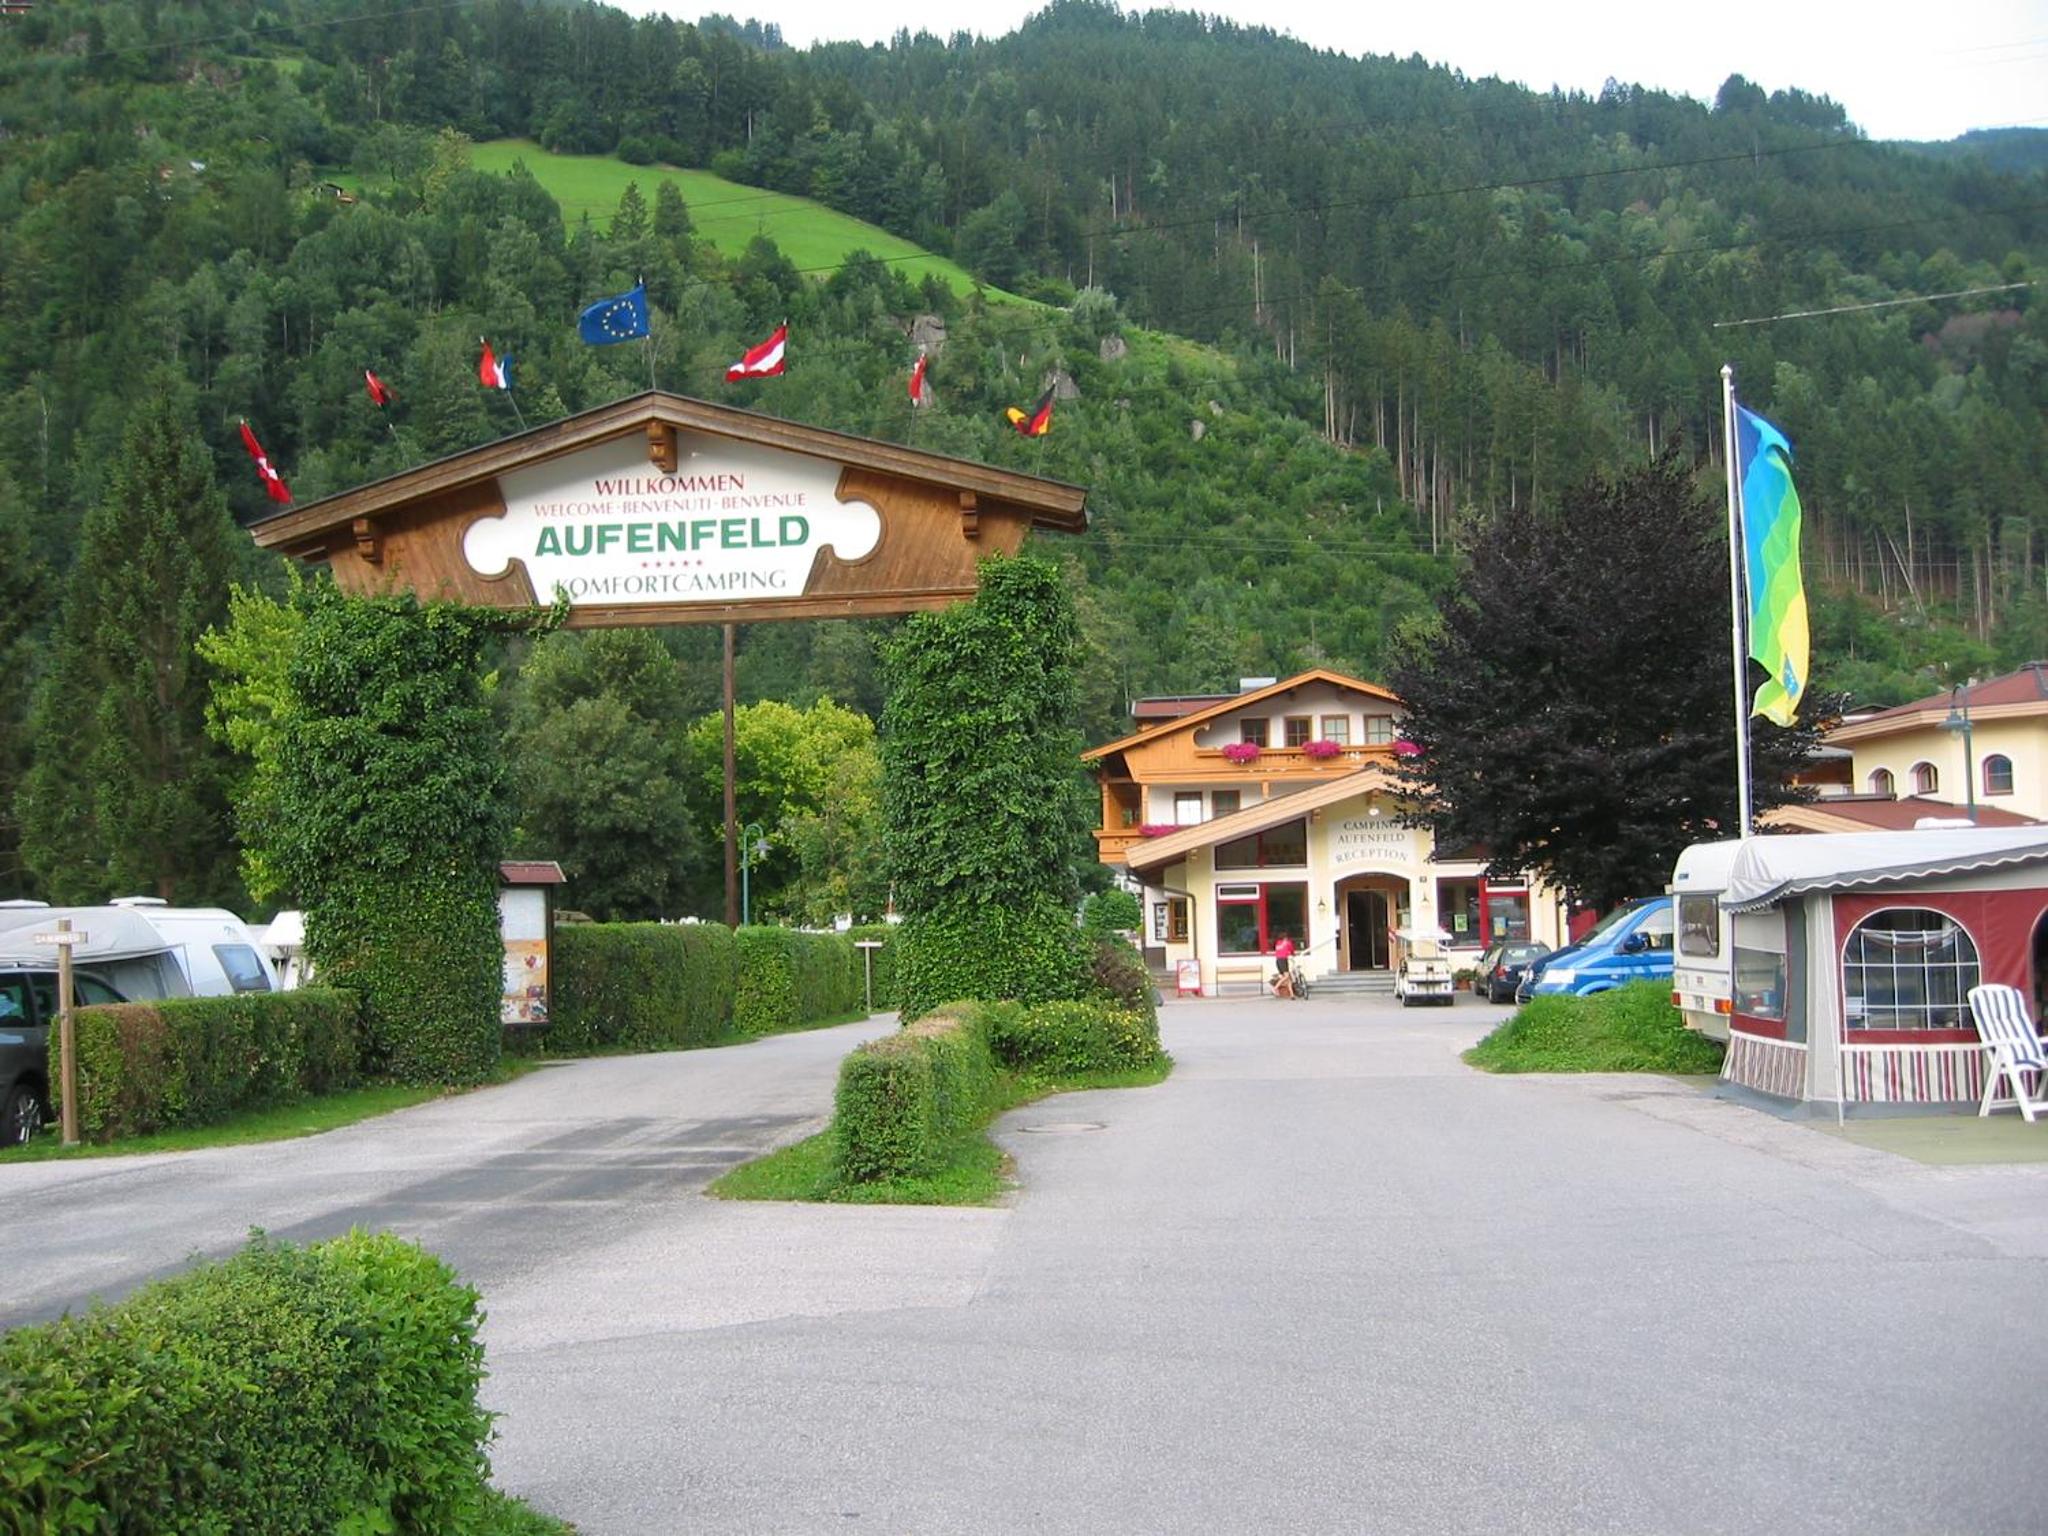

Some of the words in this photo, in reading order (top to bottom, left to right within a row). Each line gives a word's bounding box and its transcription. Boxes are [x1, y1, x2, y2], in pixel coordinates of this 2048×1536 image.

[595, 474, 744, 496] WILLKOMMEN
[534, 502, 615, 518] WELCOME
[622, 497, 712, 515] BENVENUTI
[721, 492, 806, 511] BENVENUE
[534, 515, 810, 558] AUFENFELD
[1344, 820, 1397, 830] CAMPING
[1339, 834, 1404, 843] AUFENFELD
[1336, 849, 1407, 862] RECEPTION
